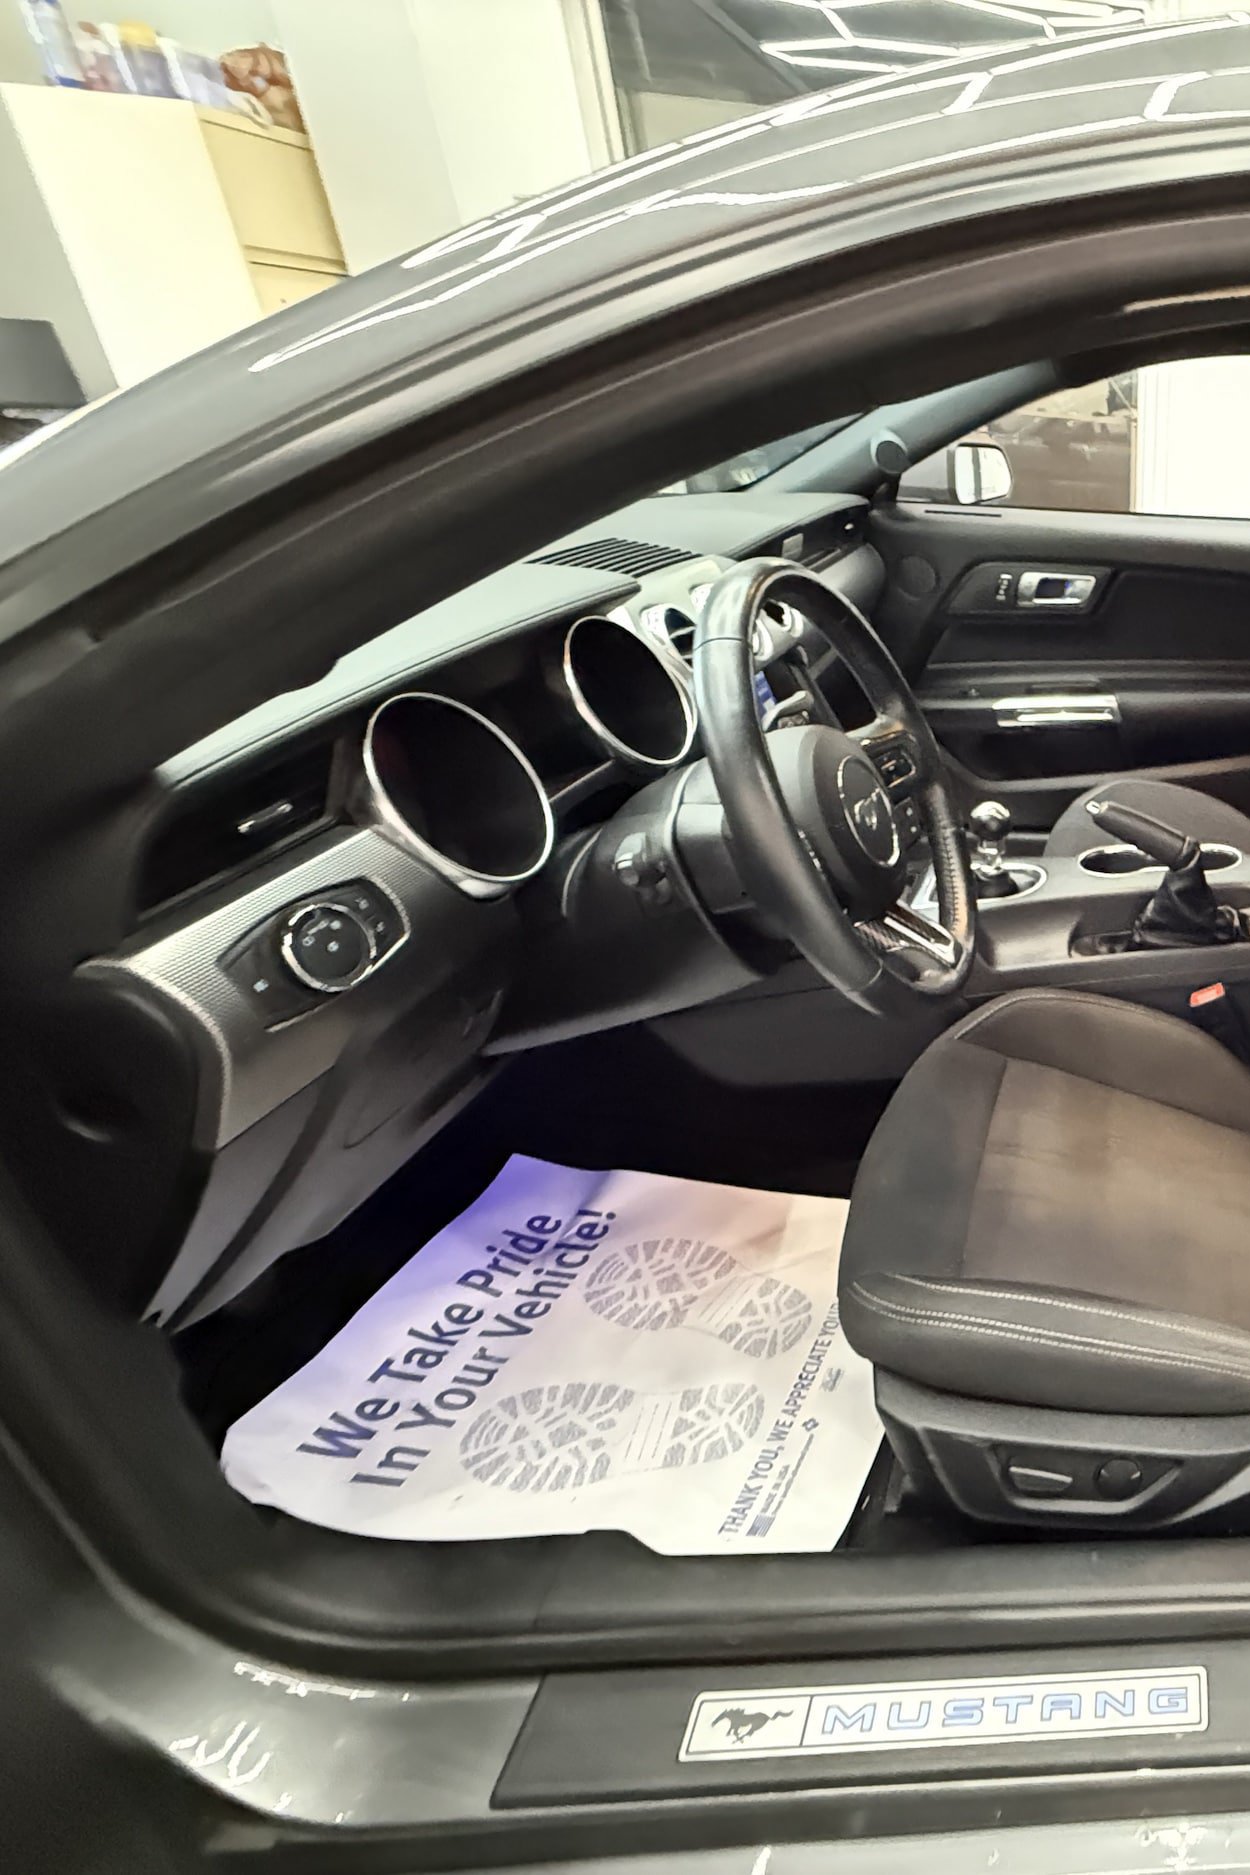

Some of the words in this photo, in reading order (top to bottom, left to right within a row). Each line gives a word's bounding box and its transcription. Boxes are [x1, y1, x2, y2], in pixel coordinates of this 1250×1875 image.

[296, 1398, 400, 1459] We
[368, 1303, 484, 1383] Take
[456, 1215, 562, 1298] Pride
[350, 1446, 431, 1487] In
[394, 1346, 509, 1431] Your
[478, 1209, 617, 1337] Vehicle!
[718, 1482, 764, 1535] THANK
[747, 1445, 785, 1480] YOU,
[767, 1419, 793, 1445] WE
[782, 1339, 831, 1418] APPRECIATE
[821, 1686, 1189, 1735] MUSTANG
